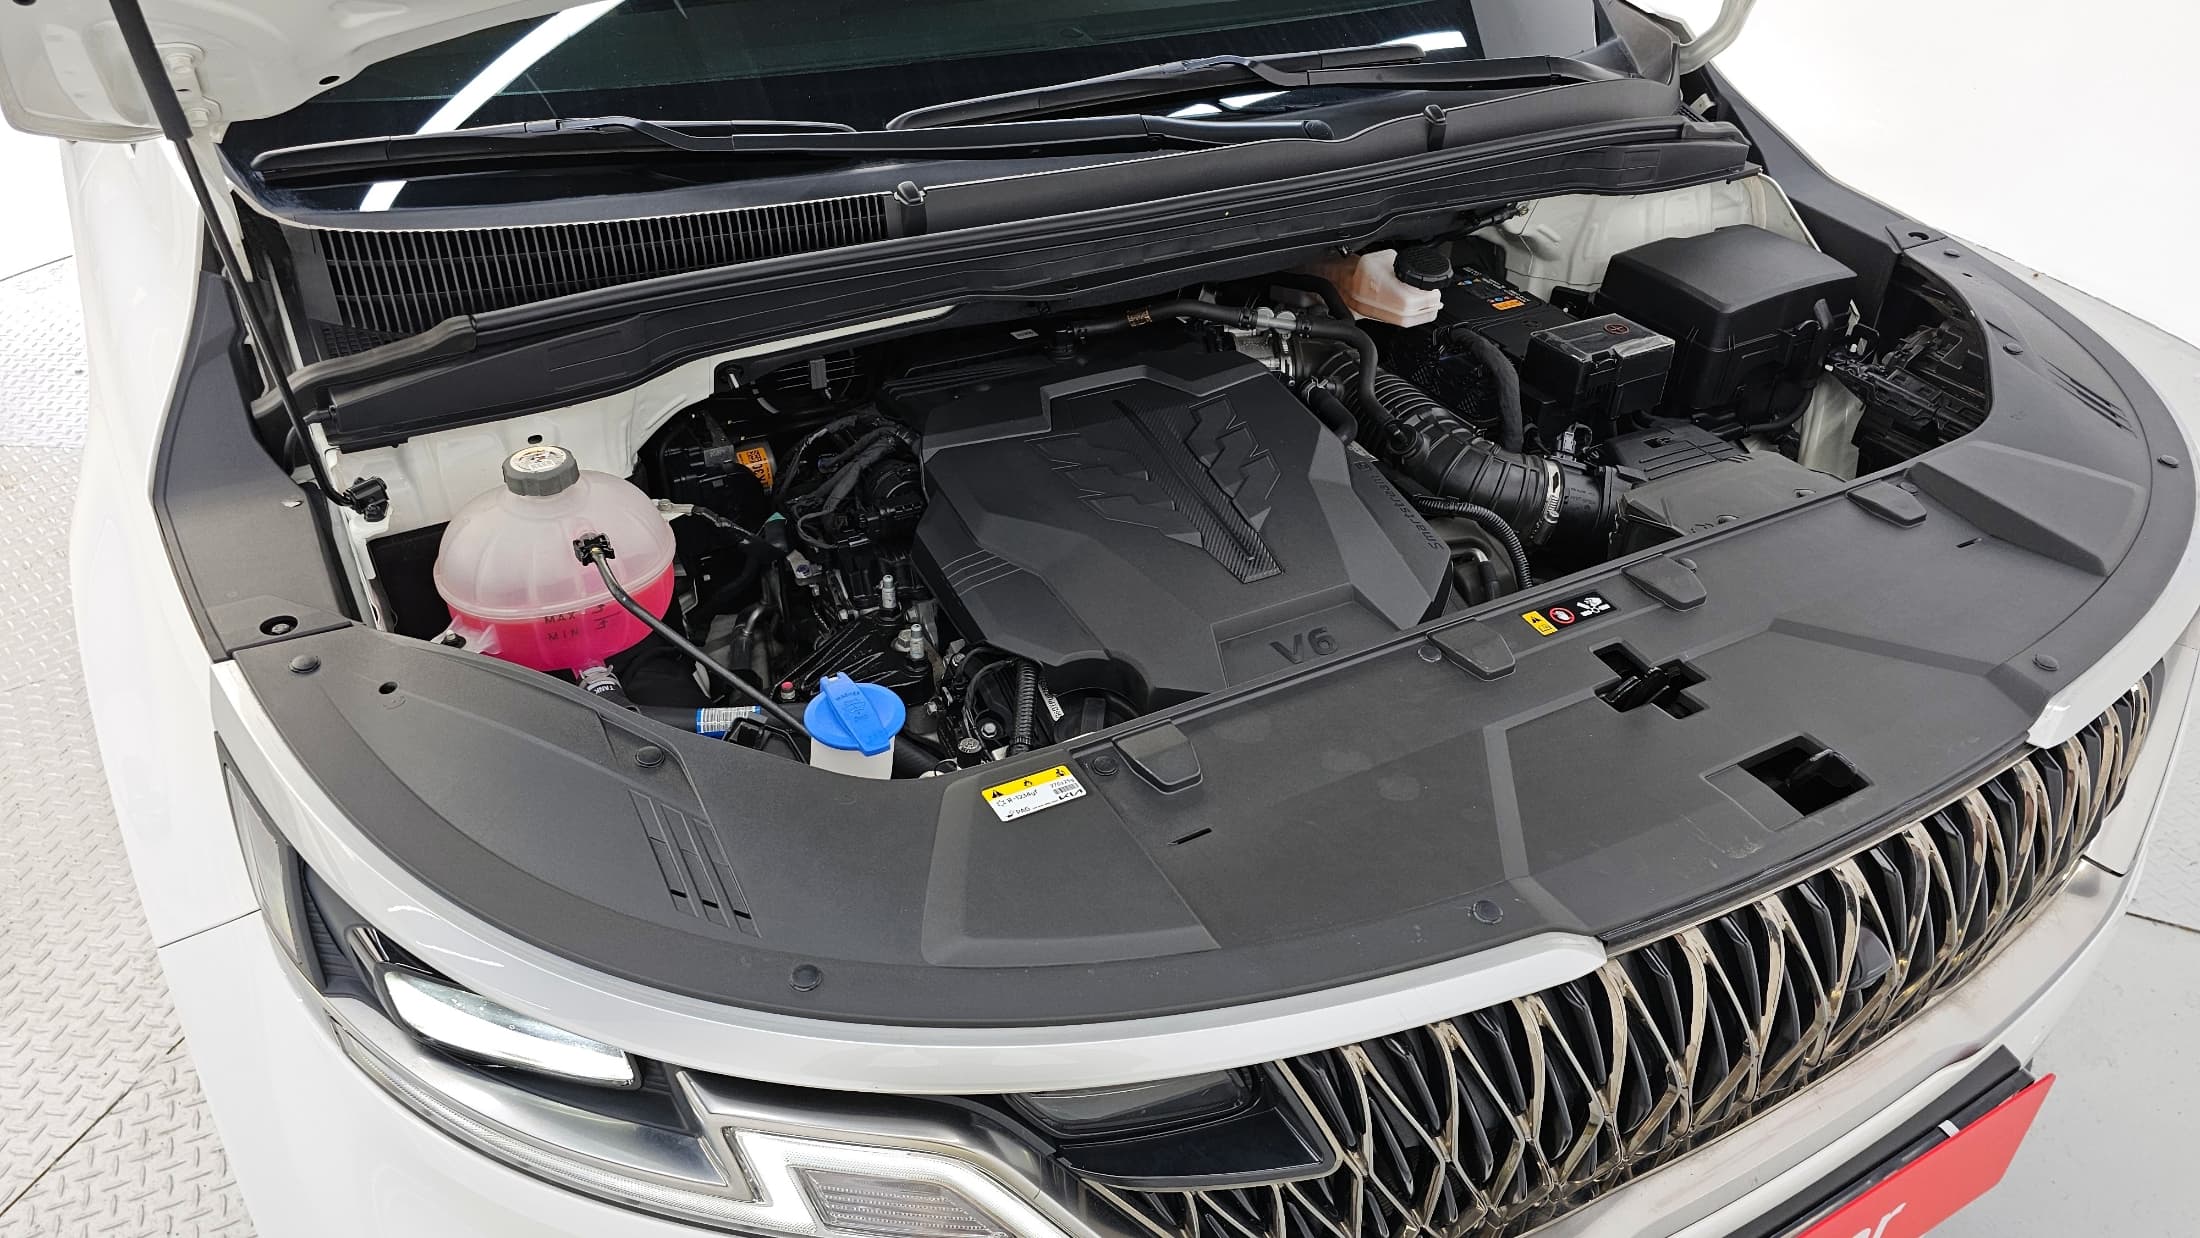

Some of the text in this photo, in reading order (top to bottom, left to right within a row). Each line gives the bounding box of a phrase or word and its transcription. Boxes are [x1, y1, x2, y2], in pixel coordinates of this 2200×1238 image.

[1370, 474, 1445, 550] Smartstream
[544, 612, 576, 624] MAX
[547, 628, 578, 640] MIN
[1269, 626, 1338, 664] V6
[594, 685, 616, 694] TANK
[1058, 788, 1083, 800] KIA
